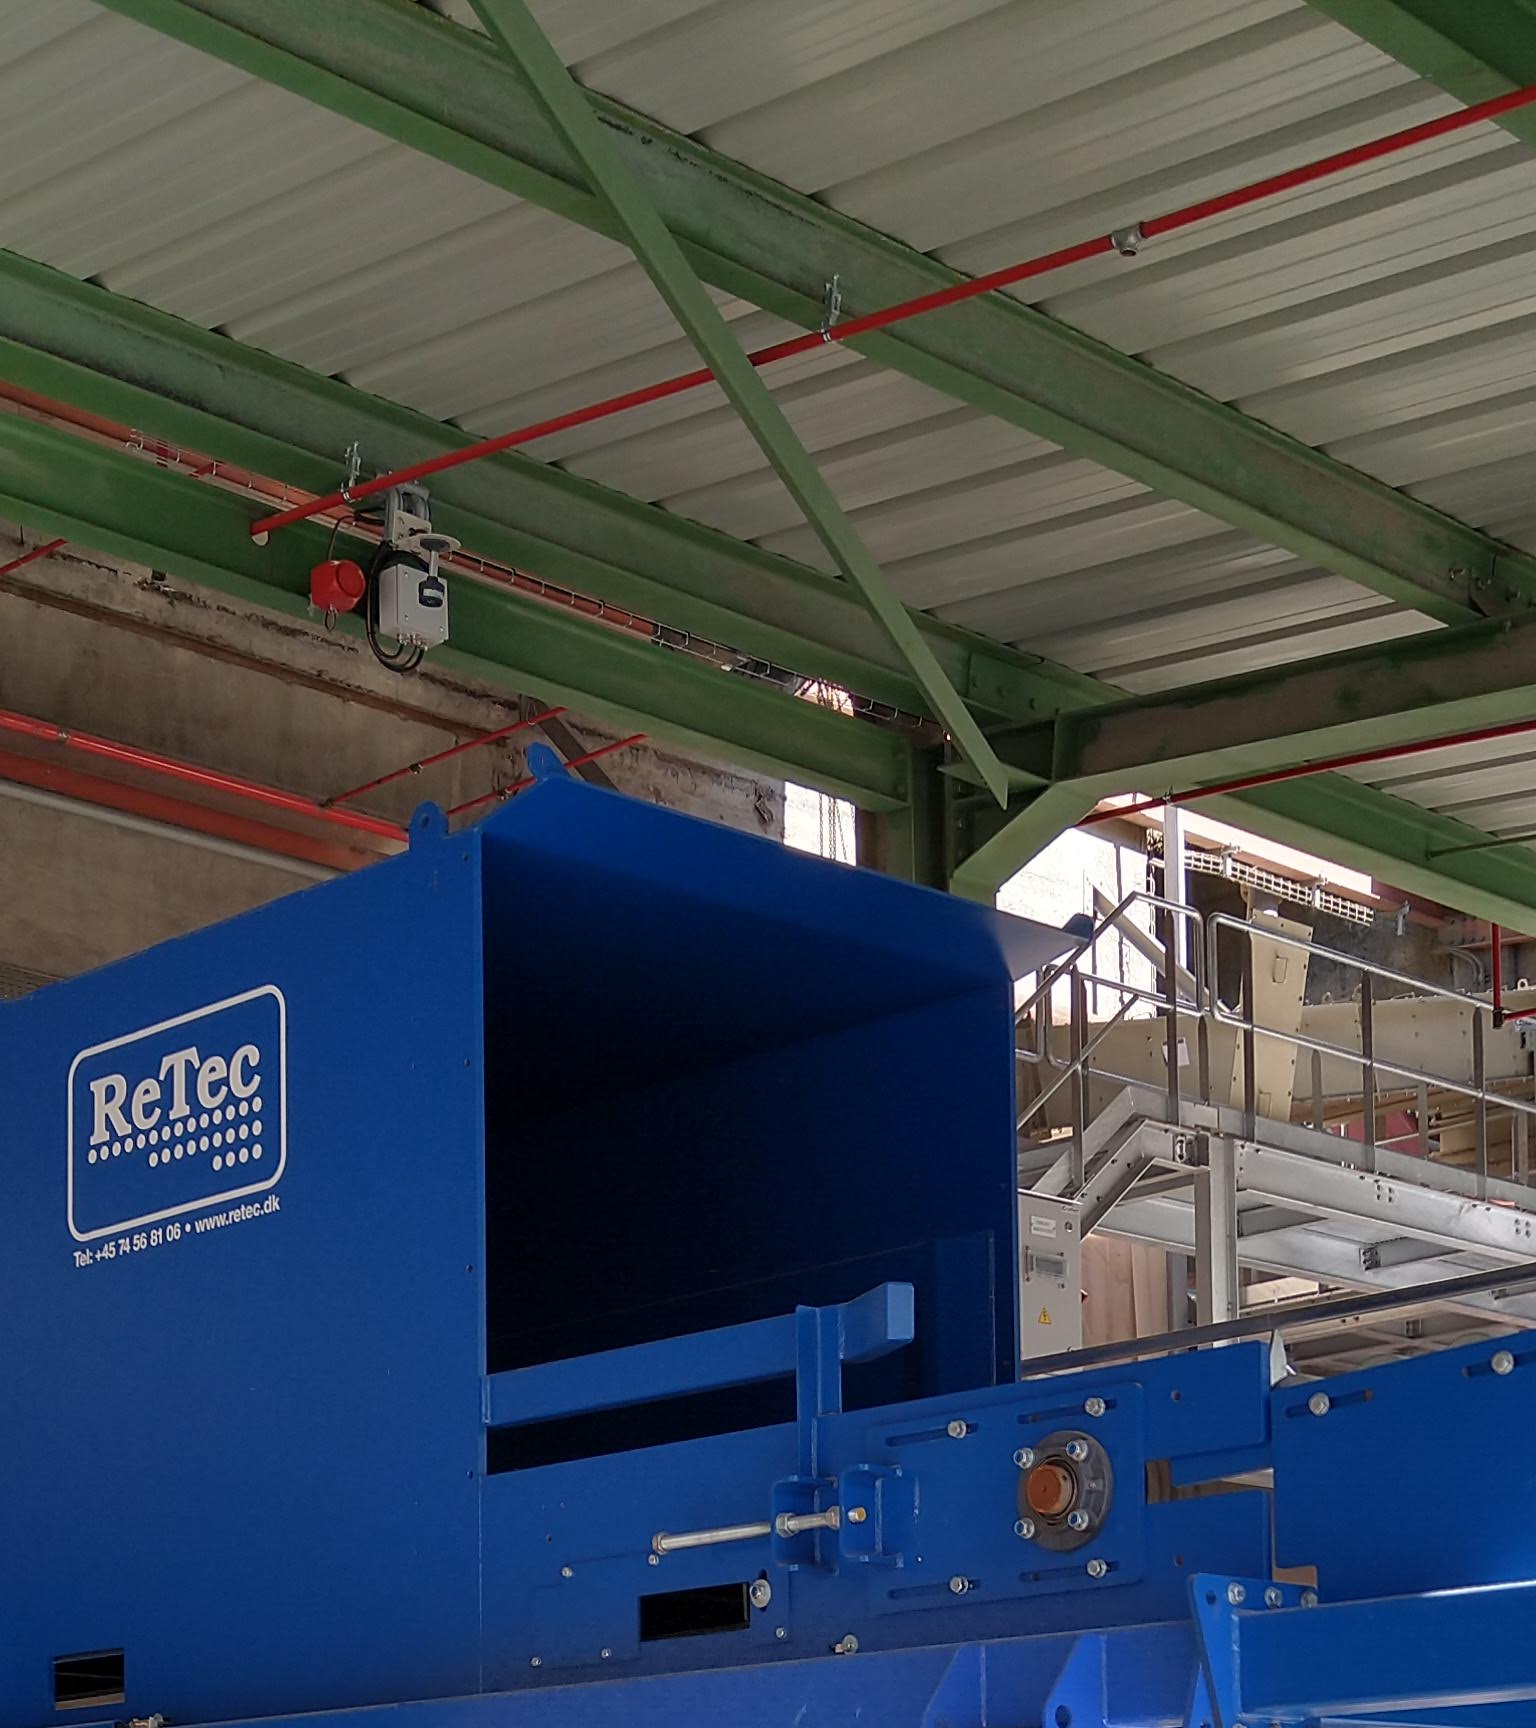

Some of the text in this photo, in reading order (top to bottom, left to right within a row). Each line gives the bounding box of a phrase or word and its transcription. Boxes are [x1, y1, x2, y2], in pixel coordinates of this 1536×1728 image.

[89, 1044, 261, 1146] ReTec
[73, 1194, 281, 1268] Tel: +45 74 56 81 06 www.retec.dk
